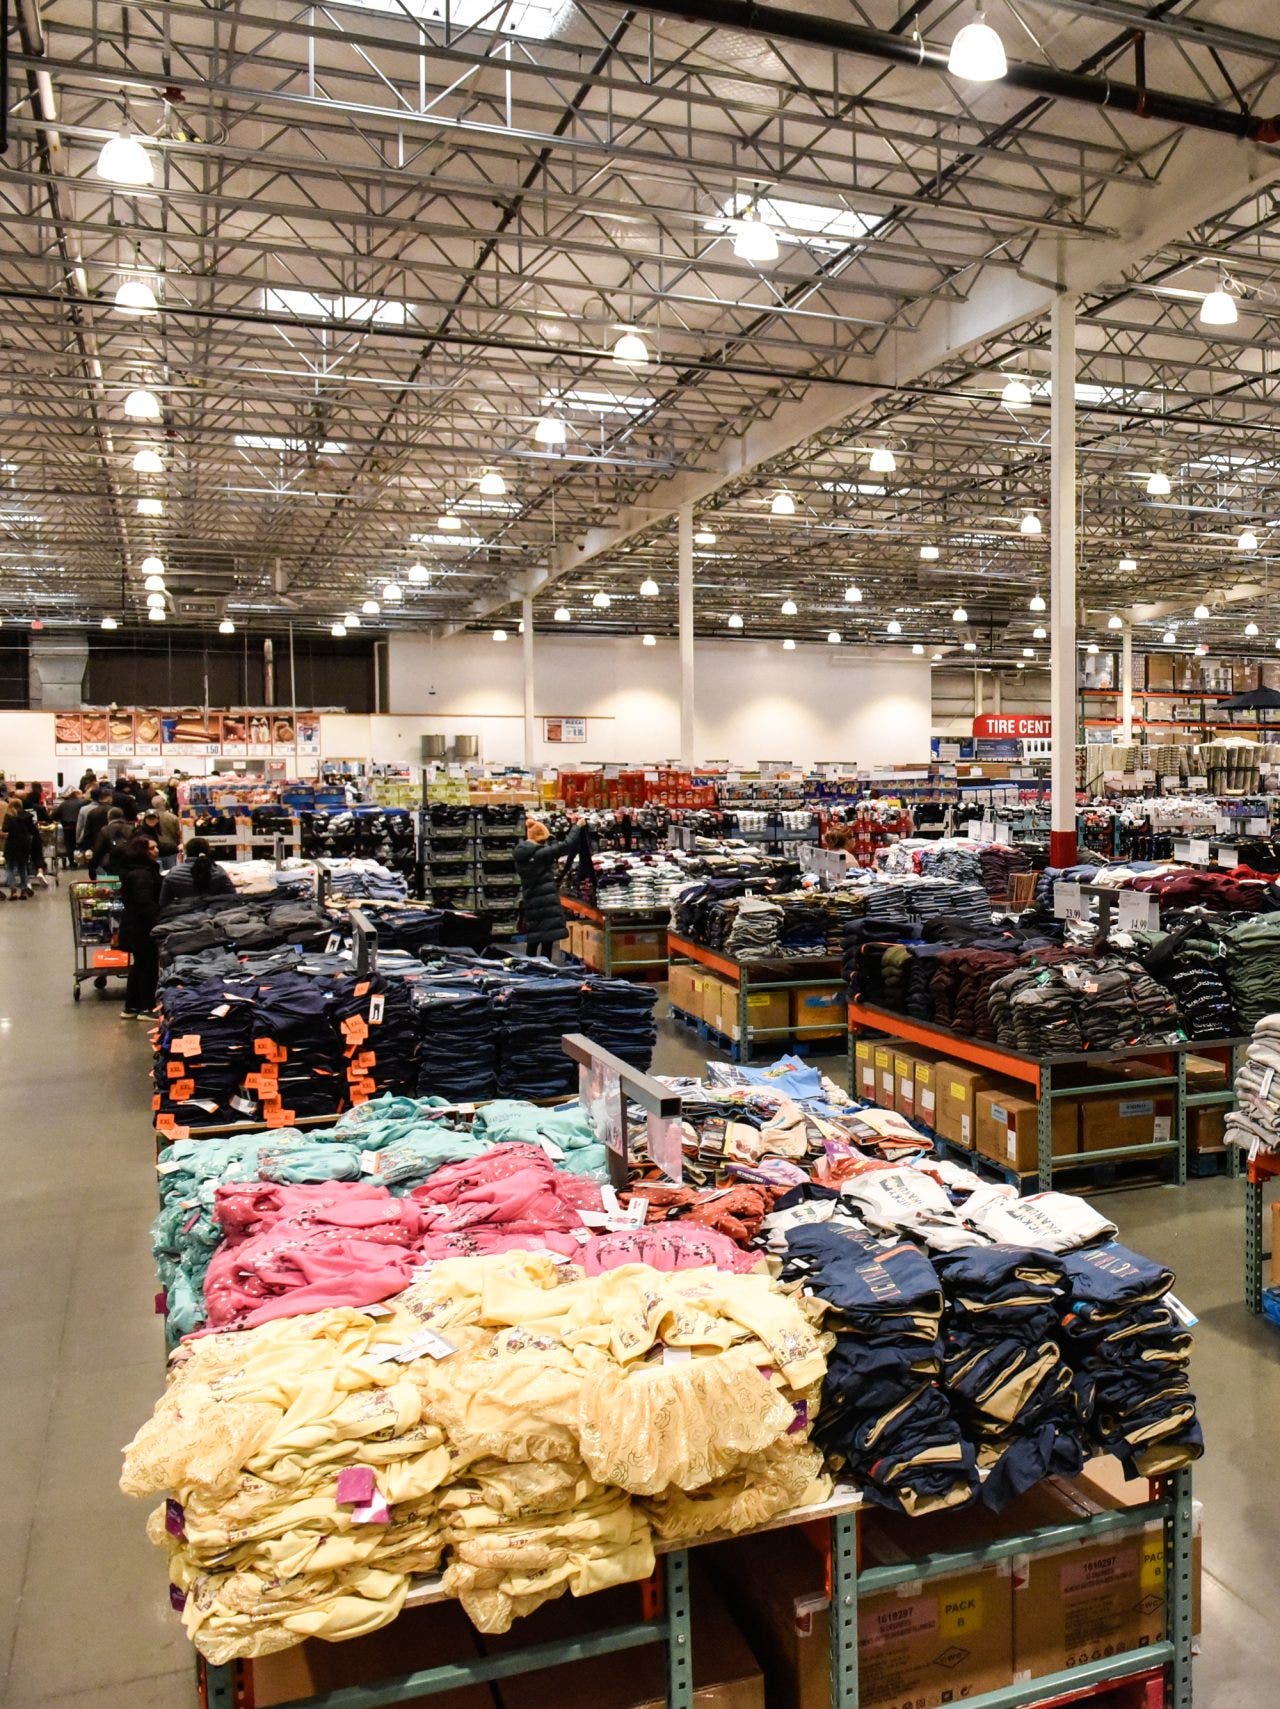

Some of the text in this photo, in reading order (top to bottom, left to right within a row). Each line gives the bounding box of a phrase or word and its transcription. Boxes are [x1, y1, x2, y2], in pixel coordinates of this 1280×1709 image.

[987, 720, 1015, 733] TIRE
[1066, 908, 1081, 919] 23.99
[1131, 919, 1147, 930] 14.99
[1155, 1567, 1161, 1576] B
[945, 1600, 976, 1614] PACK
[957, 1618, 964, 1627] B
